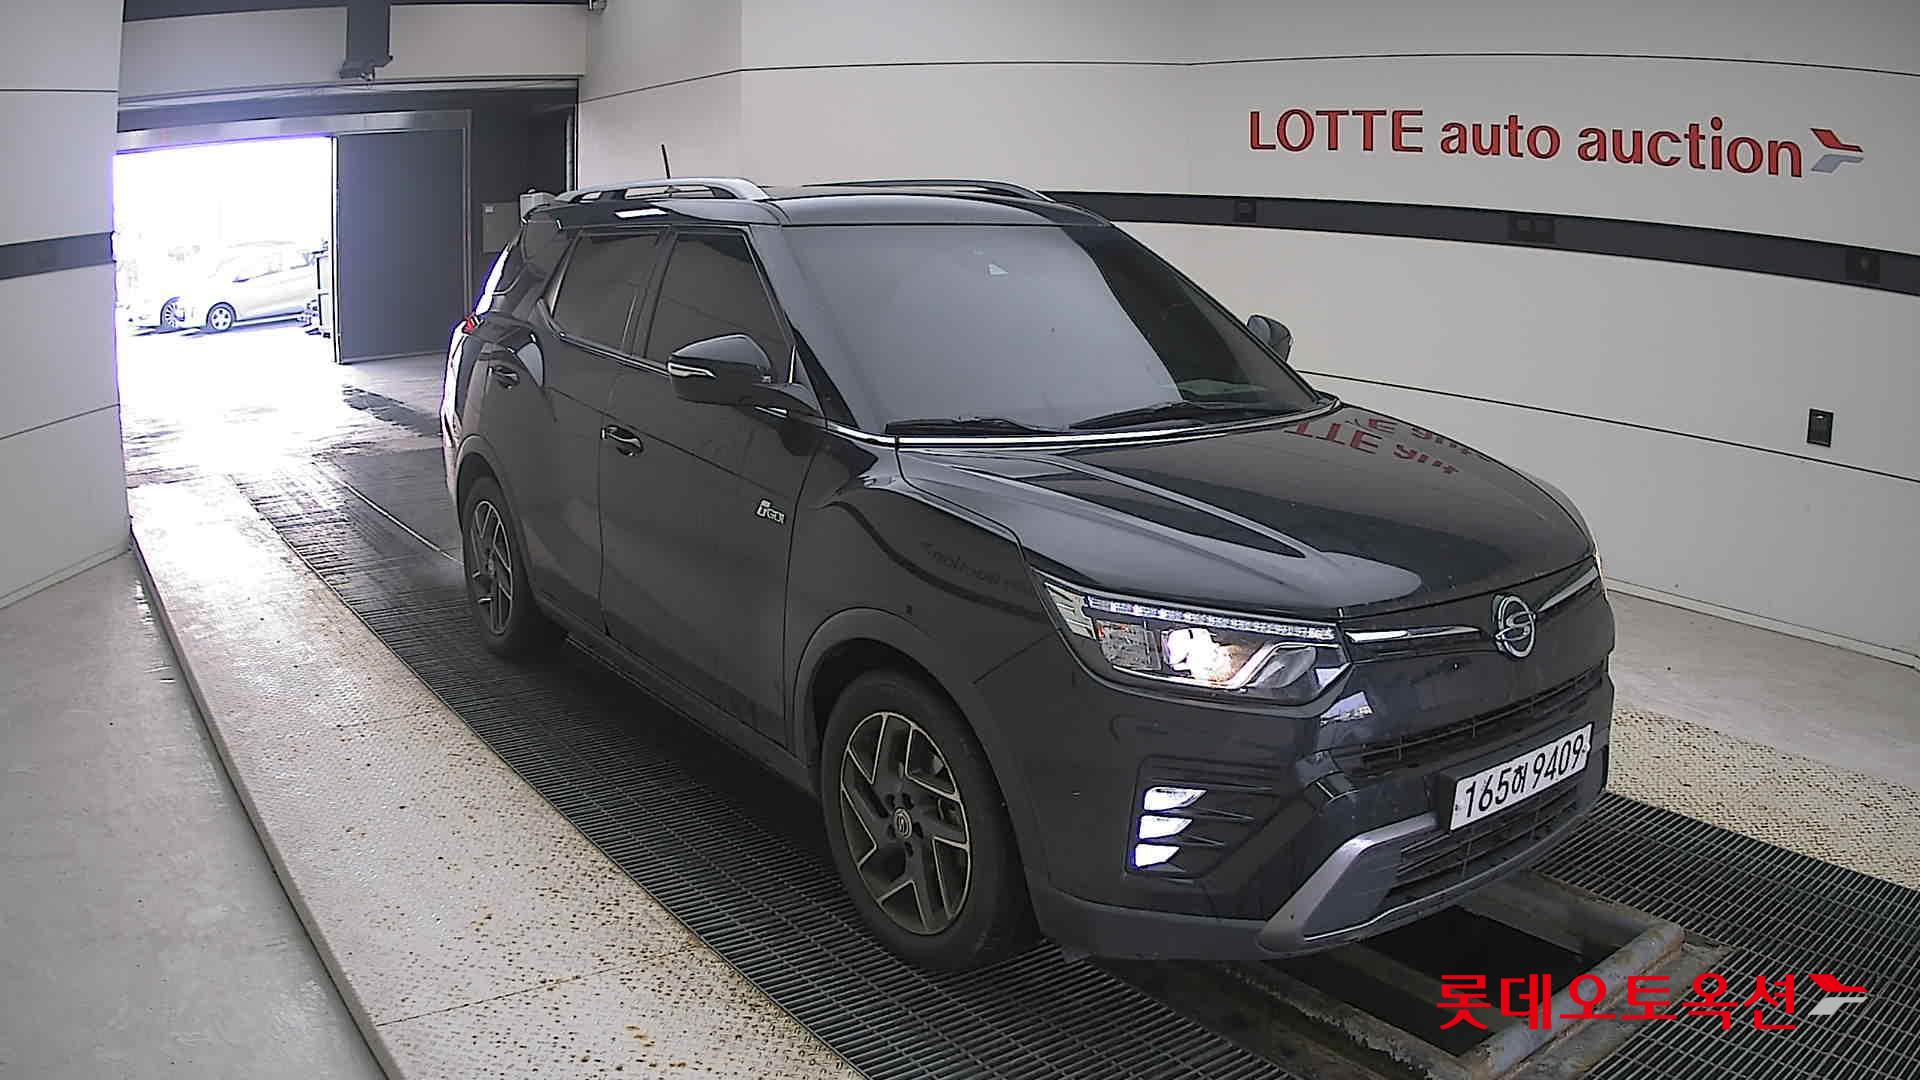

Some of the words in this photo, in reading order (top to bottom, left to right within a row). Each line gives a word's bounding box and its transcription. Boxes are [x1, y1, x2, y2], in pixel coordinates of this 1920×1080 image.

[1249, 109, 1424, 153] LOTTE
[1440, 114, 1561, 159] auto
[1577, 116, 1803, 178] auction
[1531, 733, 1584, 789] 9409
